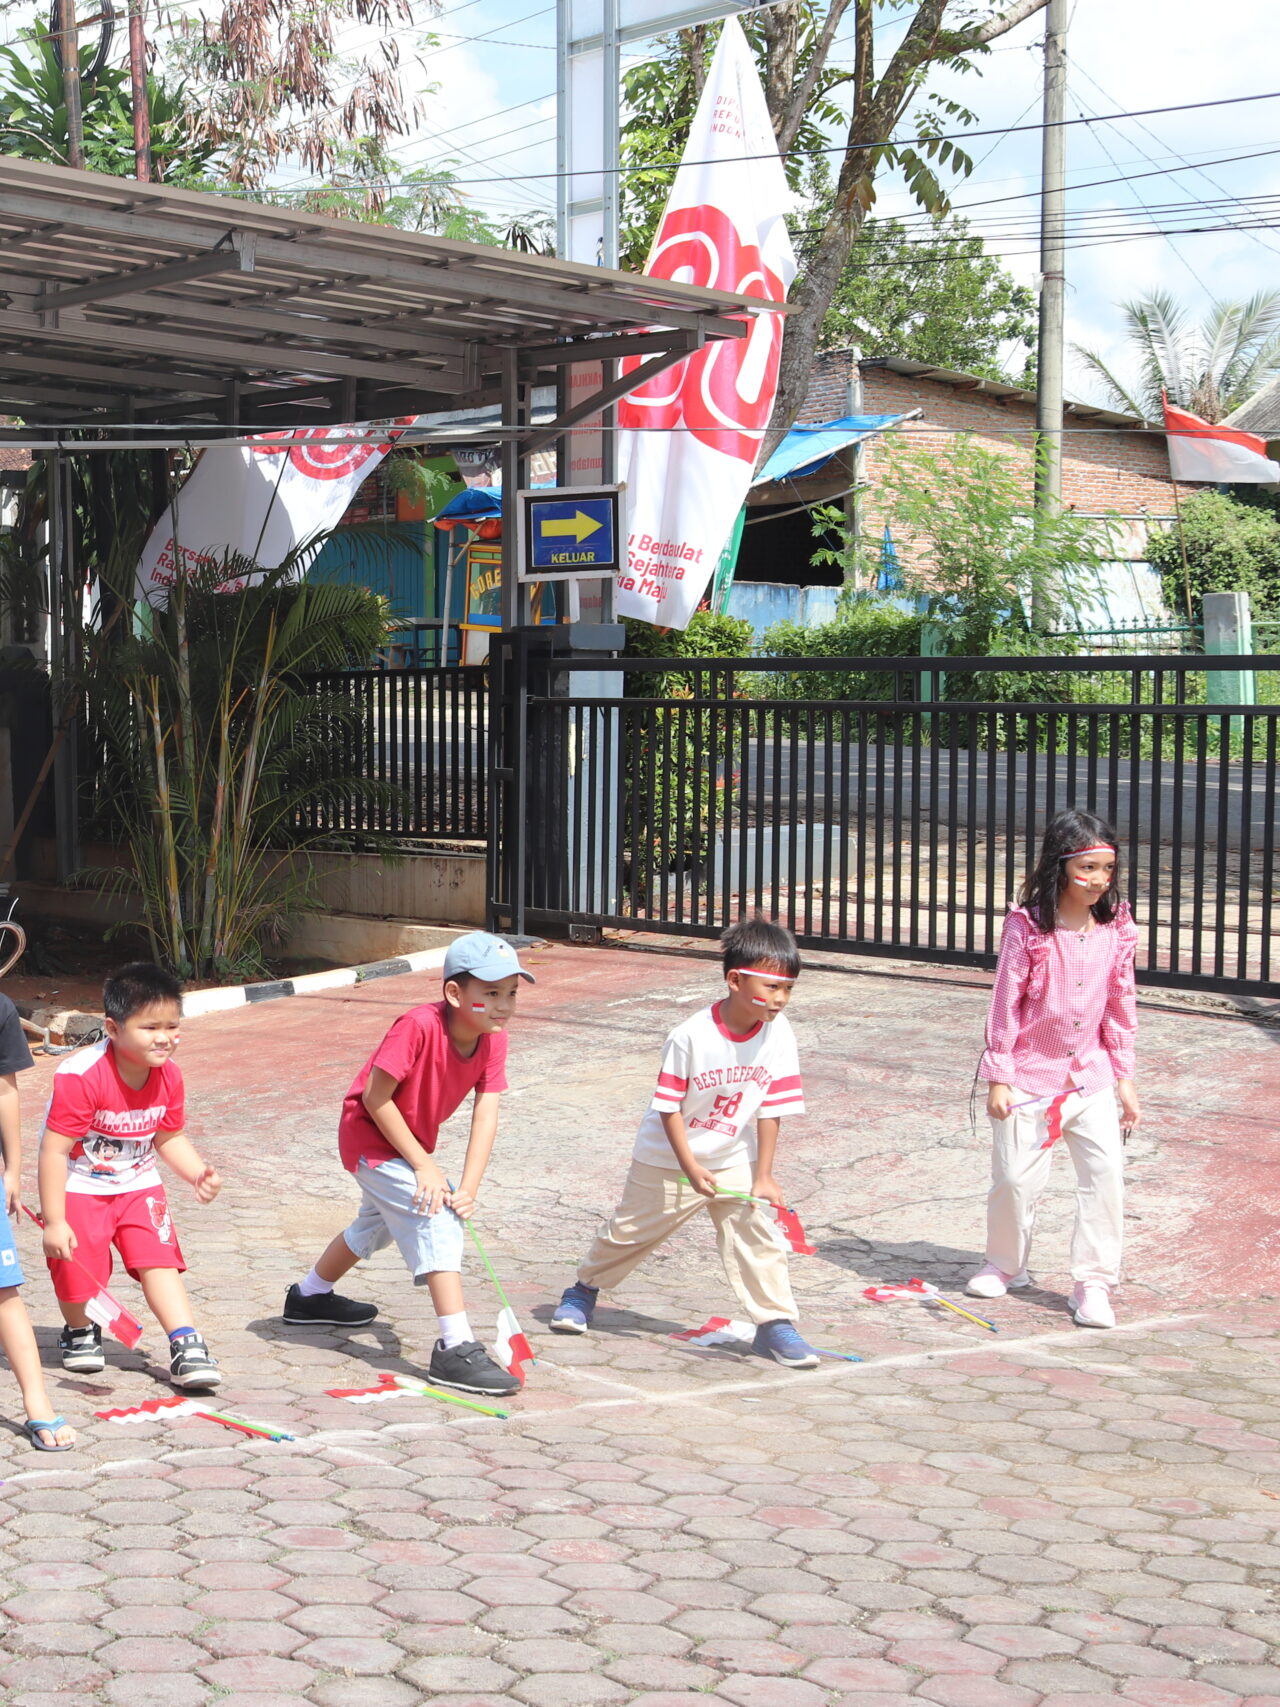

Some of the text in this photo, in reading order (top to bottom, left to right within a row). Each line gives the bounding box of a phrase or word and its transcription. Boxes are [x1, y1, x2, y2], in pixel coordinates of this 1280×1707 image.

[551, 551, 595, 564] KELUAR
[638, 534, 704, 564] Berdaulat
[693, 1068, 723, 1091] BEST
[709, 1091, 743, 1118] 58
